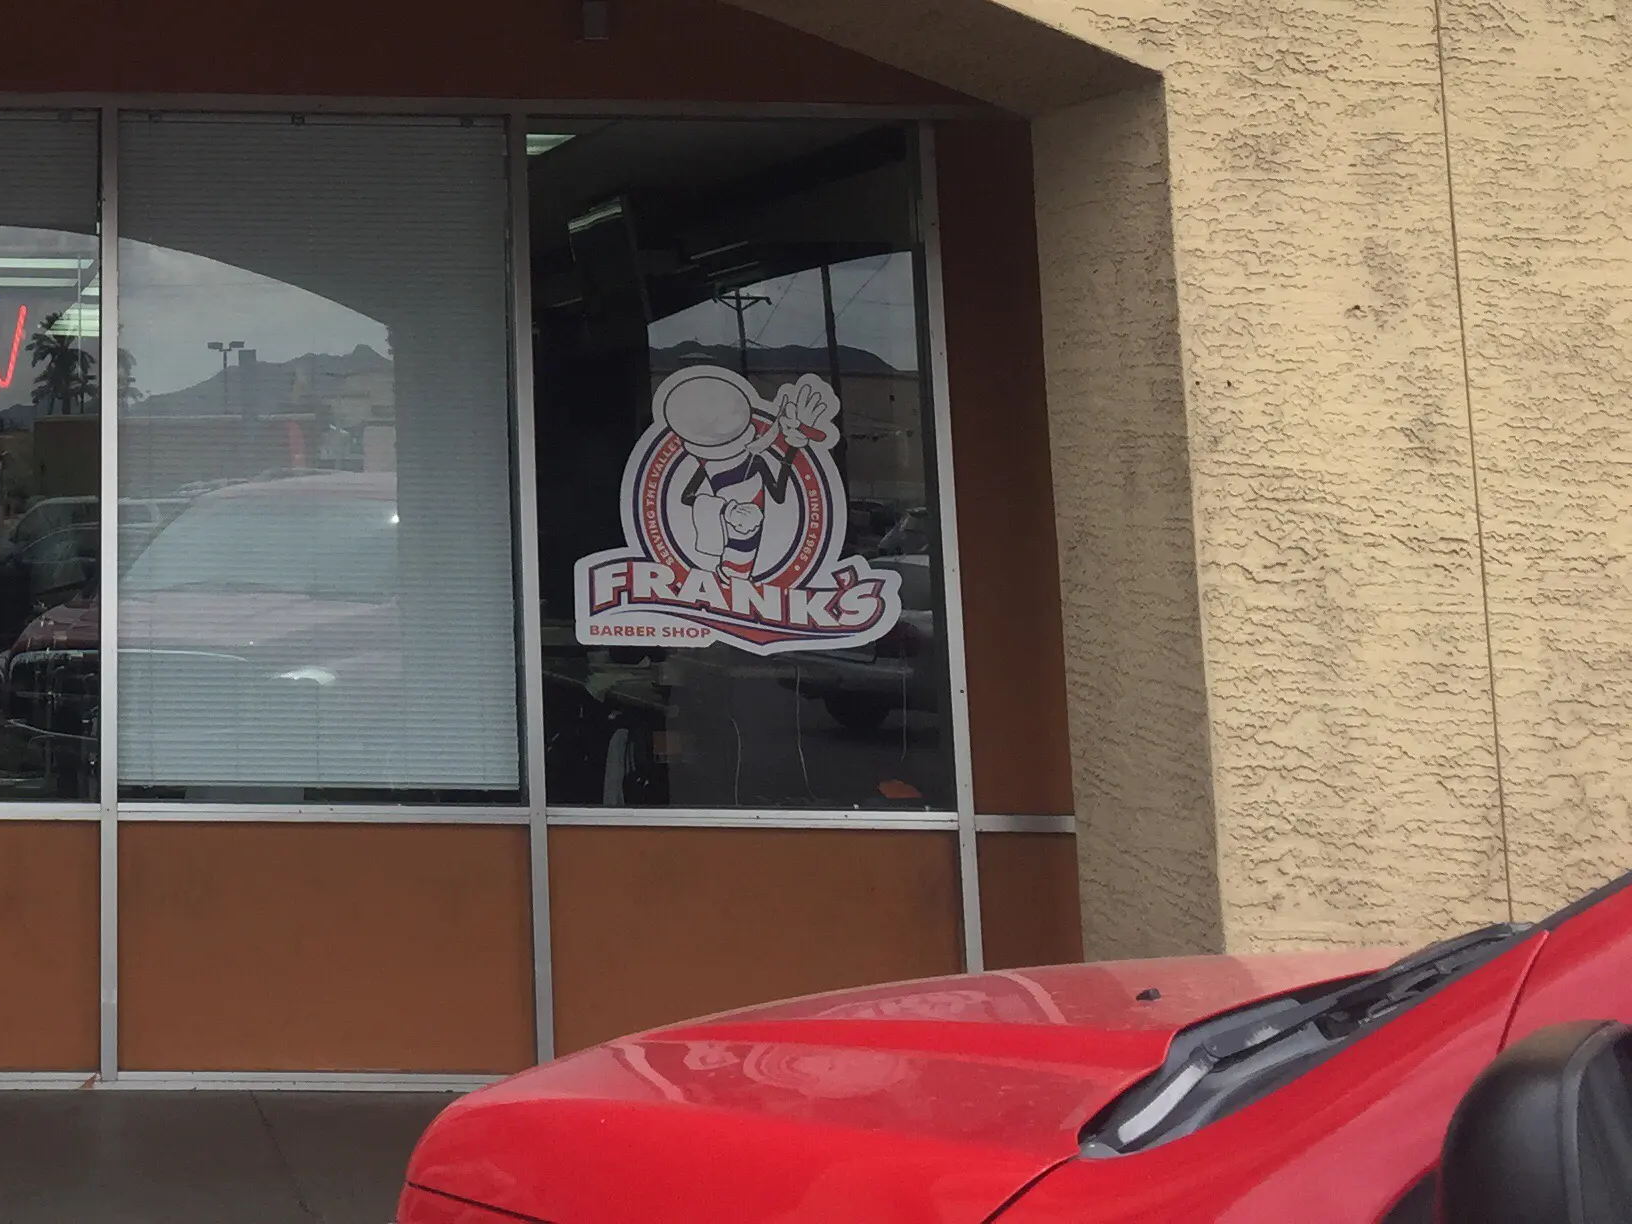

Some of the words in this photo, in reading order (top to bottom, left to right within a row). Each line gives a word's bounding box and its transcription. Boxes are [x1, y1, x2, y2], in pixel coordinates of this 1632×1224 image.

[650, 436, 682, 478] VALLEY
[646, 481, 657, 509] THE
[808, 489, 820, 531] SINCE
[646, 510, 674, 566] SERVING
[799, 533, 816, 562] 1965
[589, 562, 886, 628] FRANK'S
[590, 624, 656, 638] BARBER
[661, 625, 712, 639] SHOP
